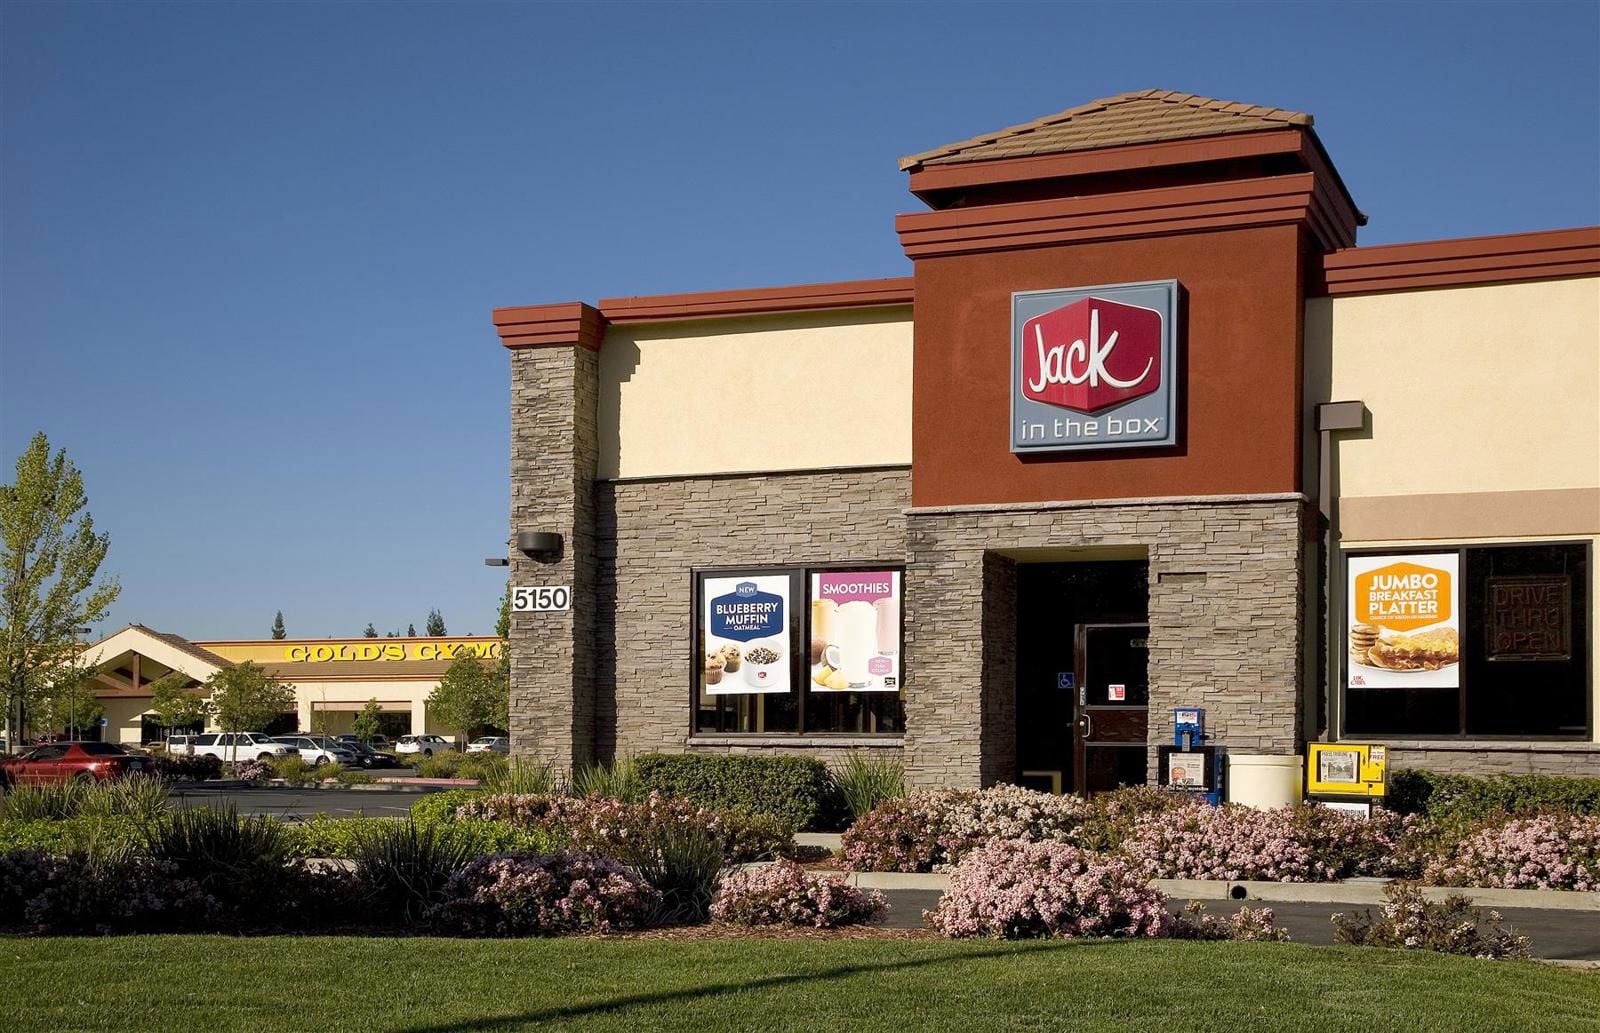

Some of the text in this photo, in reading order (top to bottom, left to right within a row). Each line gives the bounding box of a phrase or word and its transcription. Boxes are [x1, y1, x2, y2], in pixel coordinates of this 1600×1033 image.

[1029, 308, 1153, 393] Jack
[1022, 416, 1160, 440] in the box
[823, 583, 889, 594] SMOOTHIES
[1369, 573, 1438, 590] JUMBO
[514, 588, 567, 609] 5150
[1369, 590, 1438, 601] BREAKFAST
[1496, 586, 1560, 606] DRIVE
[716, 602, 778, 614] BLUEBERRY
[1369, 601, 1438, 614] PLATTER
[725, 614, 768, 625] MUFFIN
[1496, 608, 1560, 626] THRU
[1496, 631, 1561, 650] OPEN
[284, 643, 407, 663] GOLD'S
